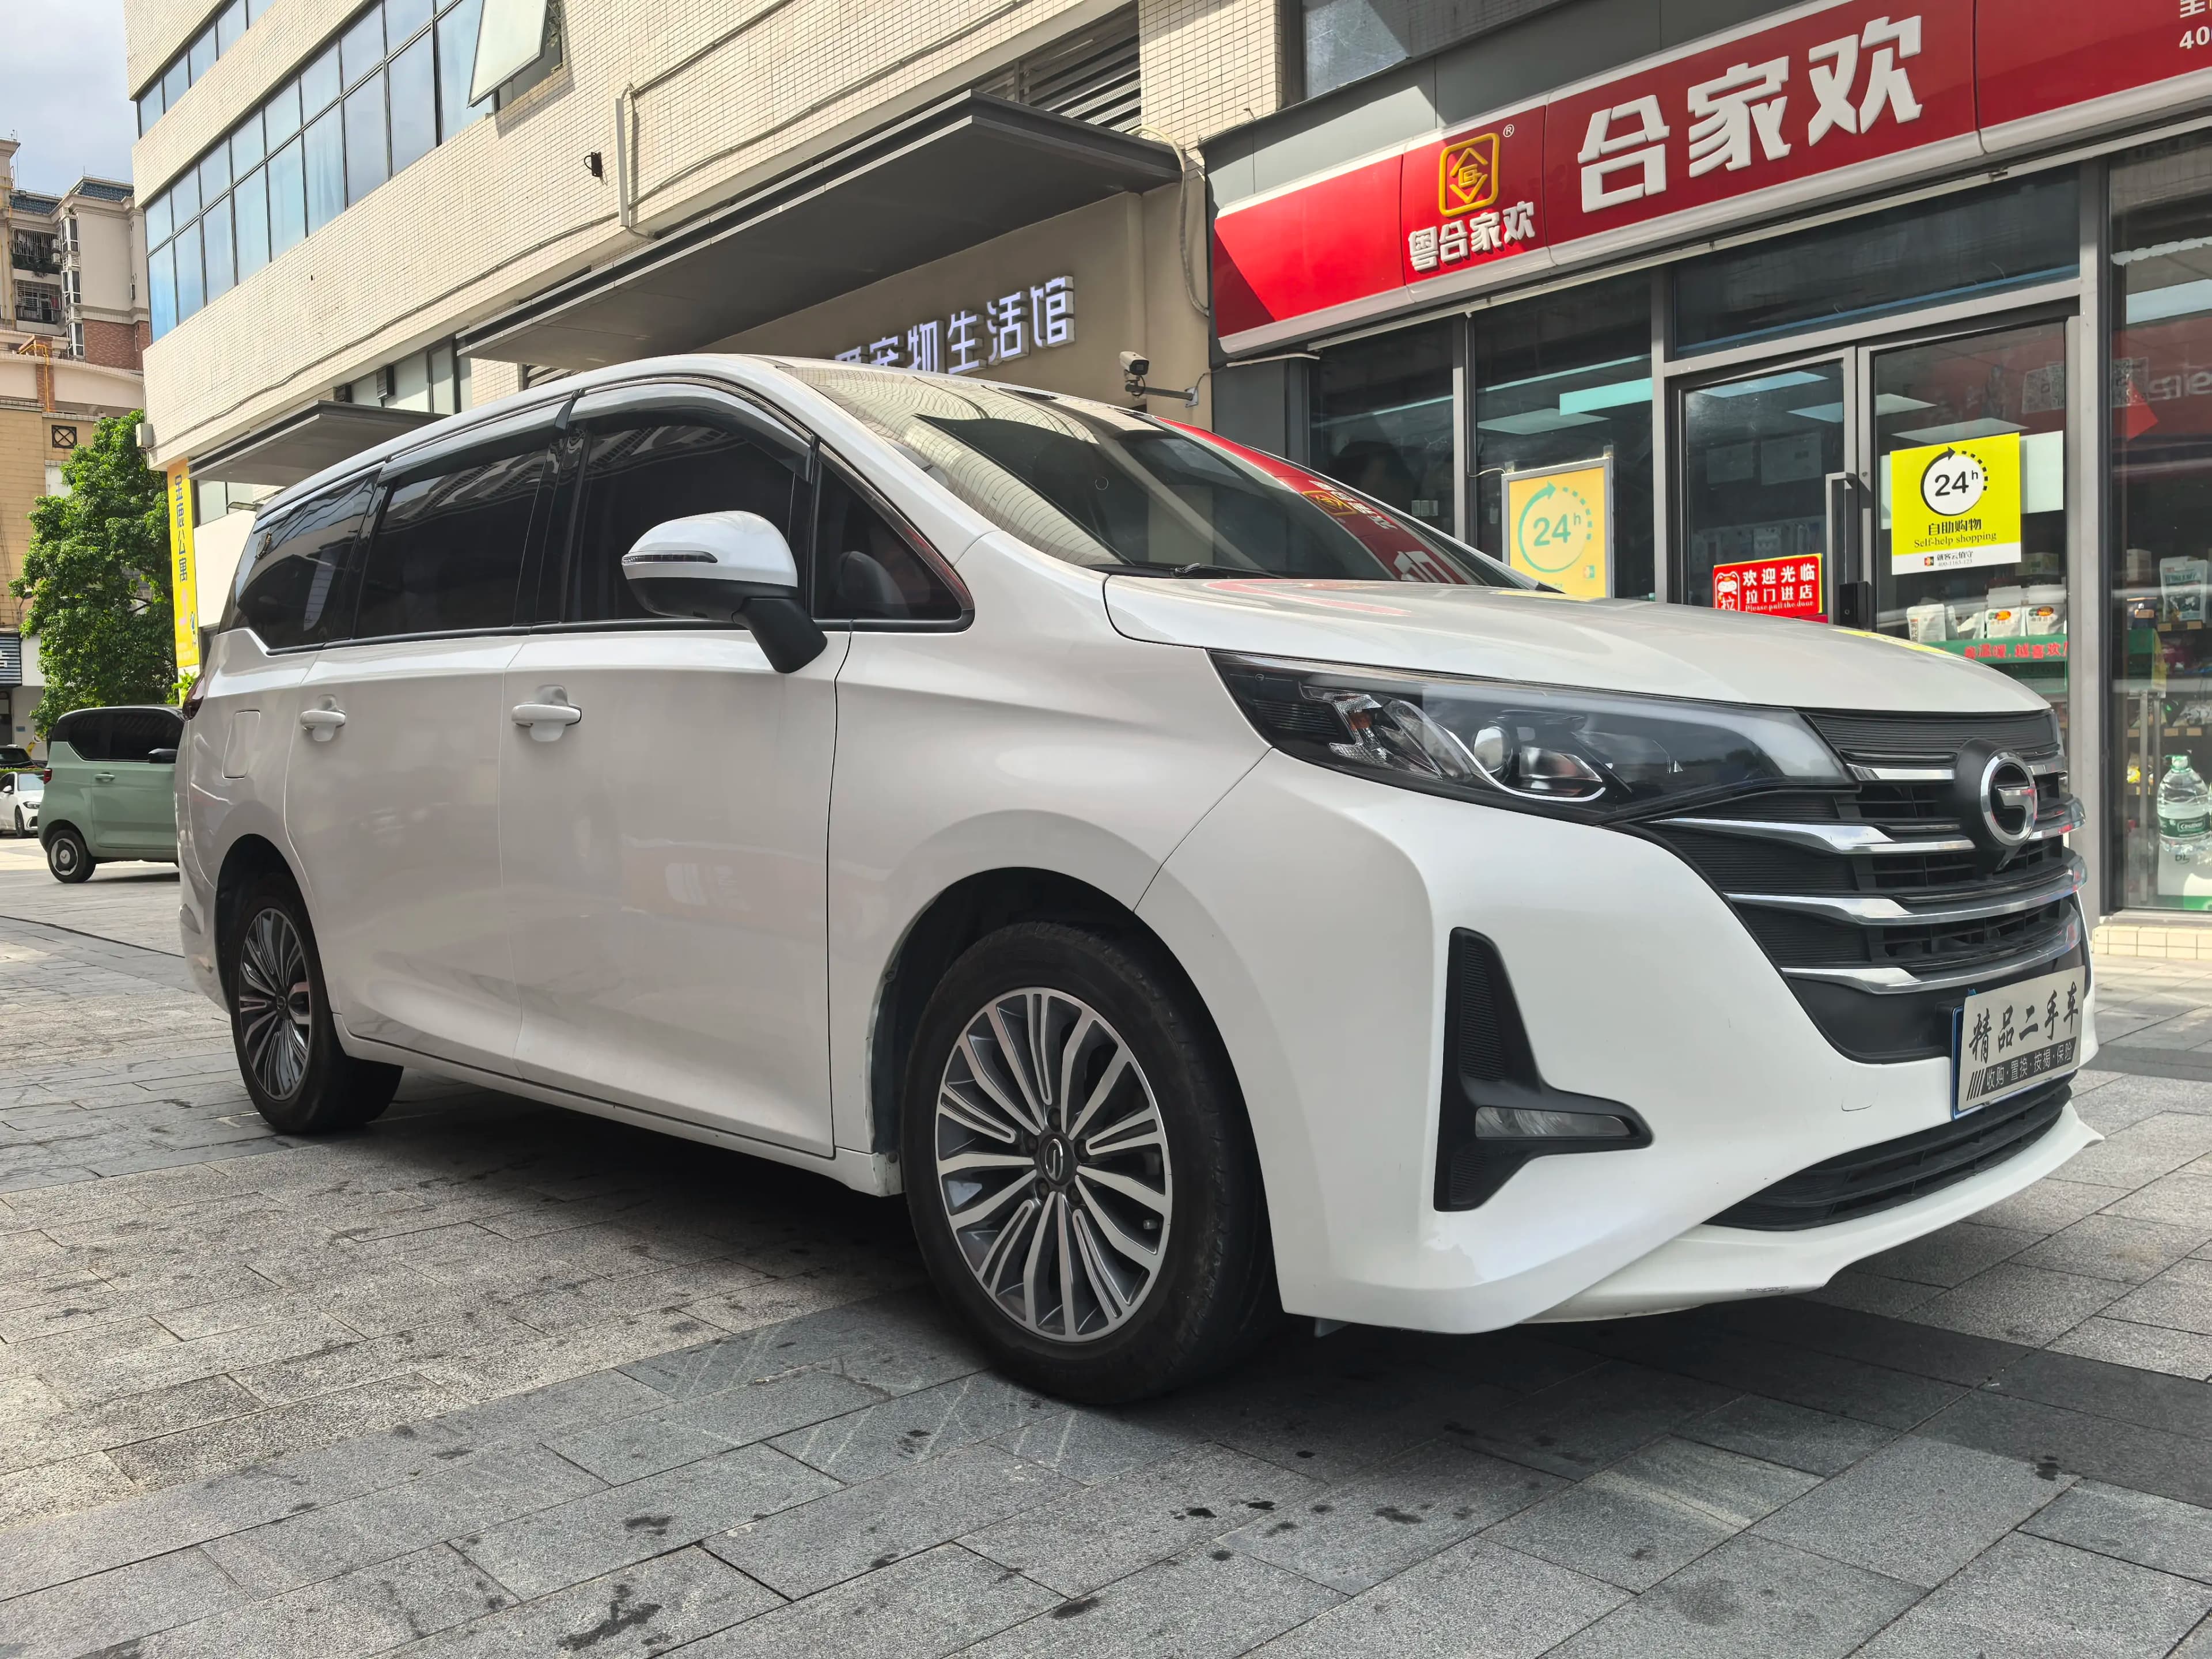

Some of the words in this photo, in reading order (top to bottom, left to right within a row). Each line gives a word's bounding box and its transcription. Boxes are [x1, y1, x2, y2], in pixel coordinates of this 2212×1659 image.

[1577, 16, 1923, 213] 合家欢
[1408, 201, 1535, 271] 粤合家欢
[1929, 518, 1982, 536] 自助购物
[1914, 536, 1953, 548] Self-help
[1956, 532, 1997, 544] shopping
[1743, 563, 1816, 586] 欢迎光临
[1745, 585, 1813, 604] 拉门进店
[1768, 601, 1782, 612] pull
[1784, 600, 1795, 608] the
[1797, 599, 1814, 607] door
[1968, 981, 2079, 1064] 精品二手车
